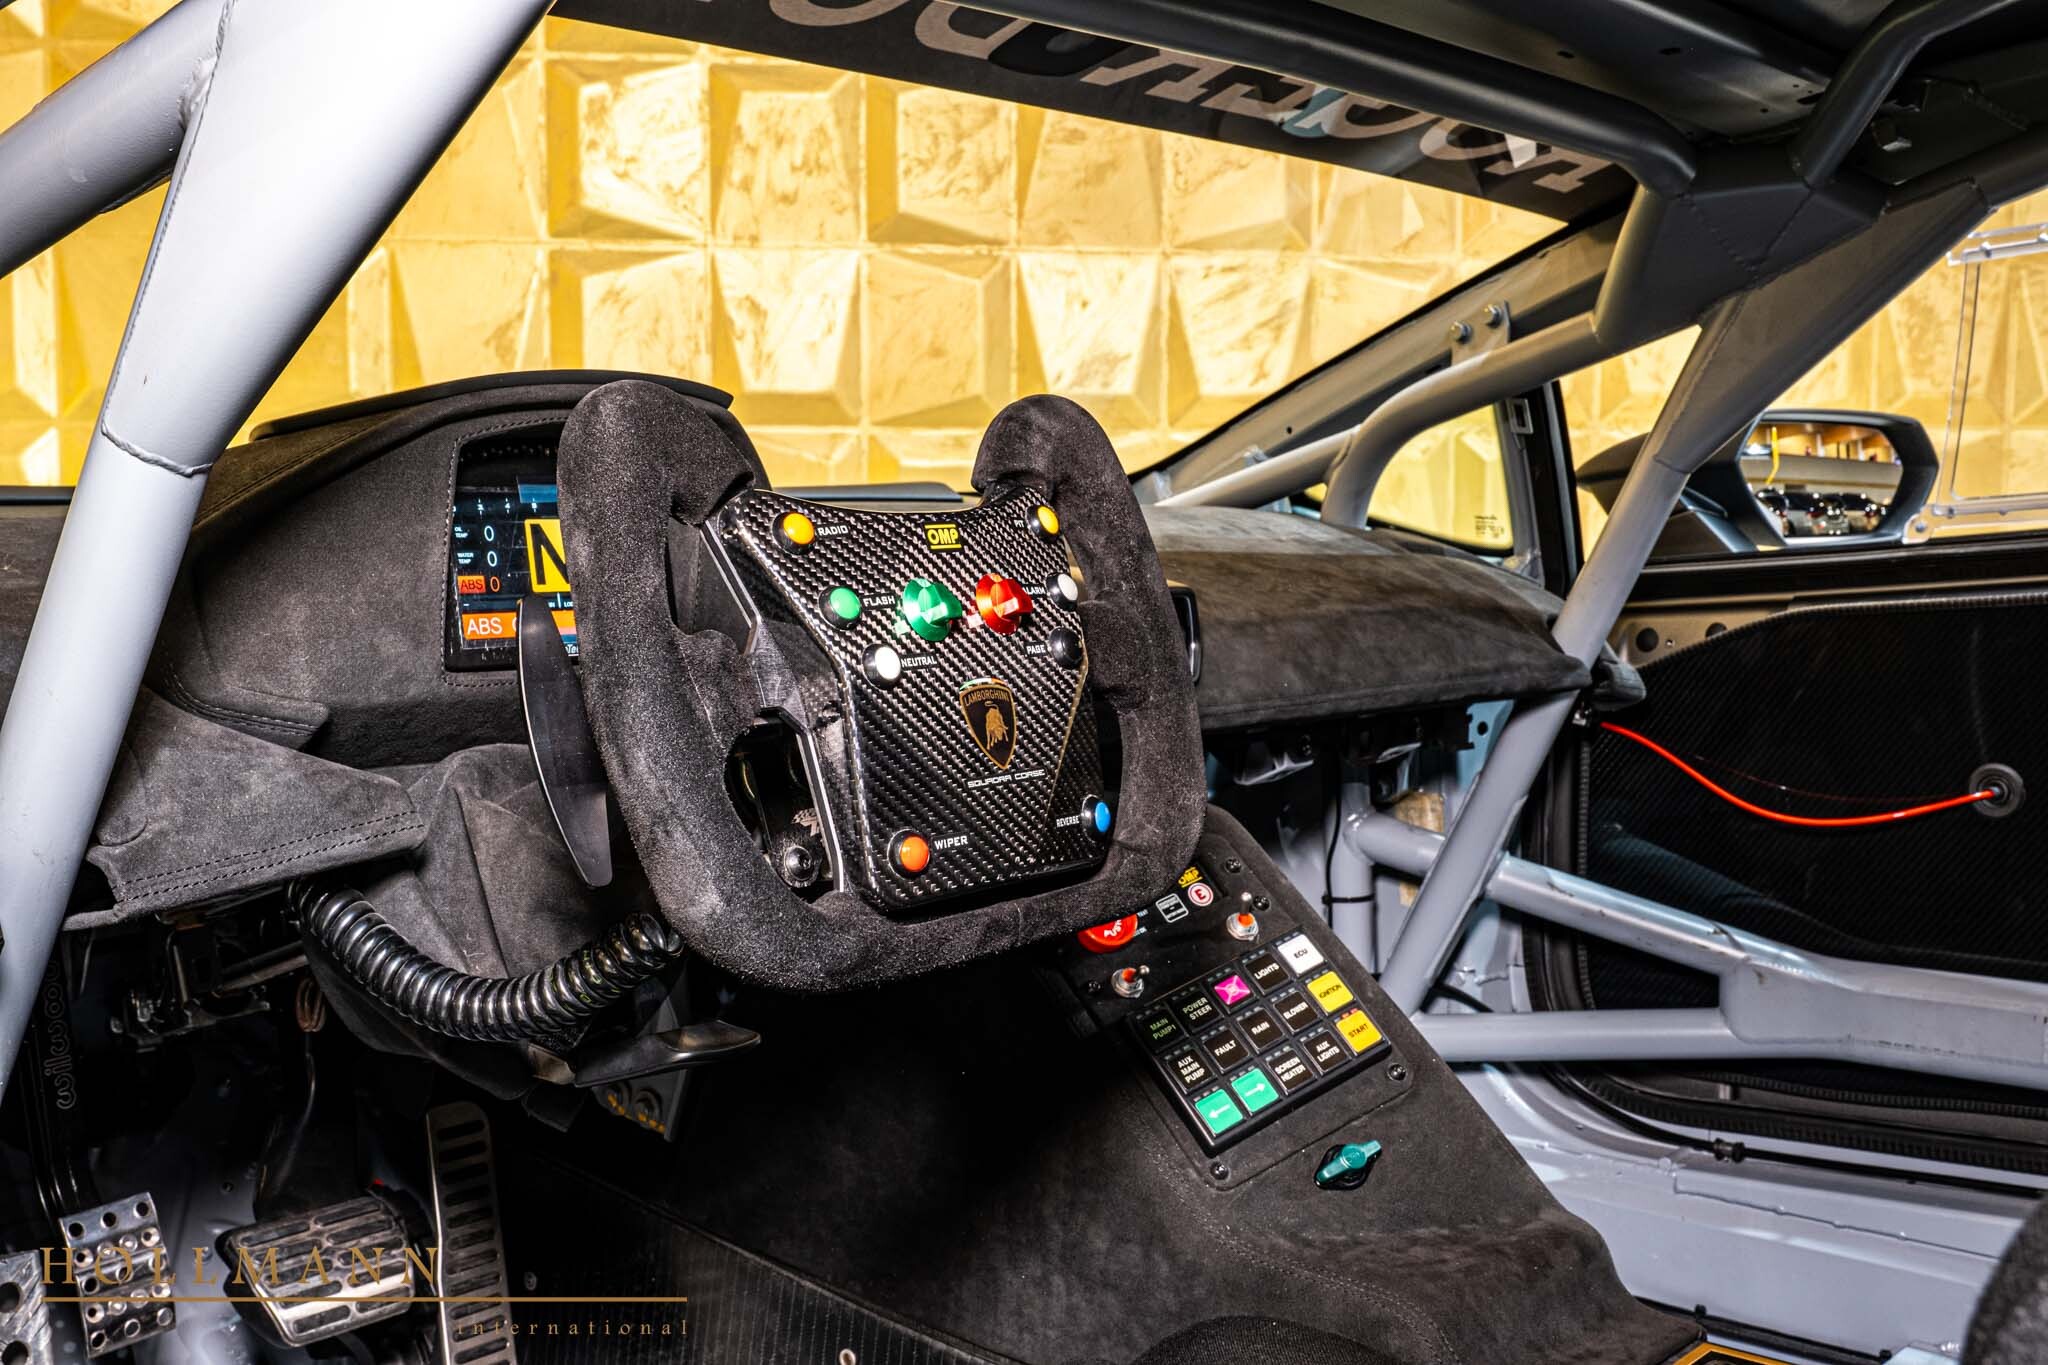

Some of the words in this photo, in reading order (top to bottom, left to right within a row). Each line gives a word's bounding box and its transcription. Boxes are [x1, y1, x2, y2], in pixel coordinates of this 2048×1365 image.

[817, 525, 848, 536] RADIO
[1014, 519, 1025, 527] PIT
[484, 525, 494, 542] 0
[927, 529, 959, 544] OMP
[487, 550, 498, 567] 0
[460, 579, 483, 590] ABS
[490, 576, 500, 592] 0
[863, 595, 896, 607] FLASH
[467, 617, 503, 635] ABS
[1026, 644, 1046, 656] PAGE
[901, 655, 938, 667] NEUTRAL
[964, 688, 1010, 707] LAMBORGHINI
[967, 774, 1012, 789] SQUADRA
[1014, 769, 1046, 780] CORSE
[1056, 815, 1080, 828] REVERSE
[934, 835, 969, 850] WIPER
[1194, 888, 1206, 900] E
[1293, 949, 1309, 959] ECU
[1254, 962, 1280, 980] LIGHTS
[1319, 983, 1343, 999] IGNITION
[1182, 997, 1208, 1014] POWER
[1189, 1004, 1213, 1020] STEER
[1283, 1001, 1309, 1019] BLOWER
[1149, 1018, 1169, 1031] MAIN
[1152, 1024, 1177, 1040] PUMP1
[1251, 1021, 1270, 1035] RAIN
[1348, 1023, 1369, 1038] START
[1214, 1040, 1236, 1056] FAULT
[1316, 1041, 1330, 1052] AUX
[1316, 1045, 1340, 1062] LIGHTS
[1177, 1056, 1194, 1068] AUX
[1180, 1061, 1200, 1076] MAIN
[1274, 1056, 1301, 1074] SCREEN
[1184, 1067, 1205, 1083] PUMP
[1281, 1064, 1306, 1082] HEATER
